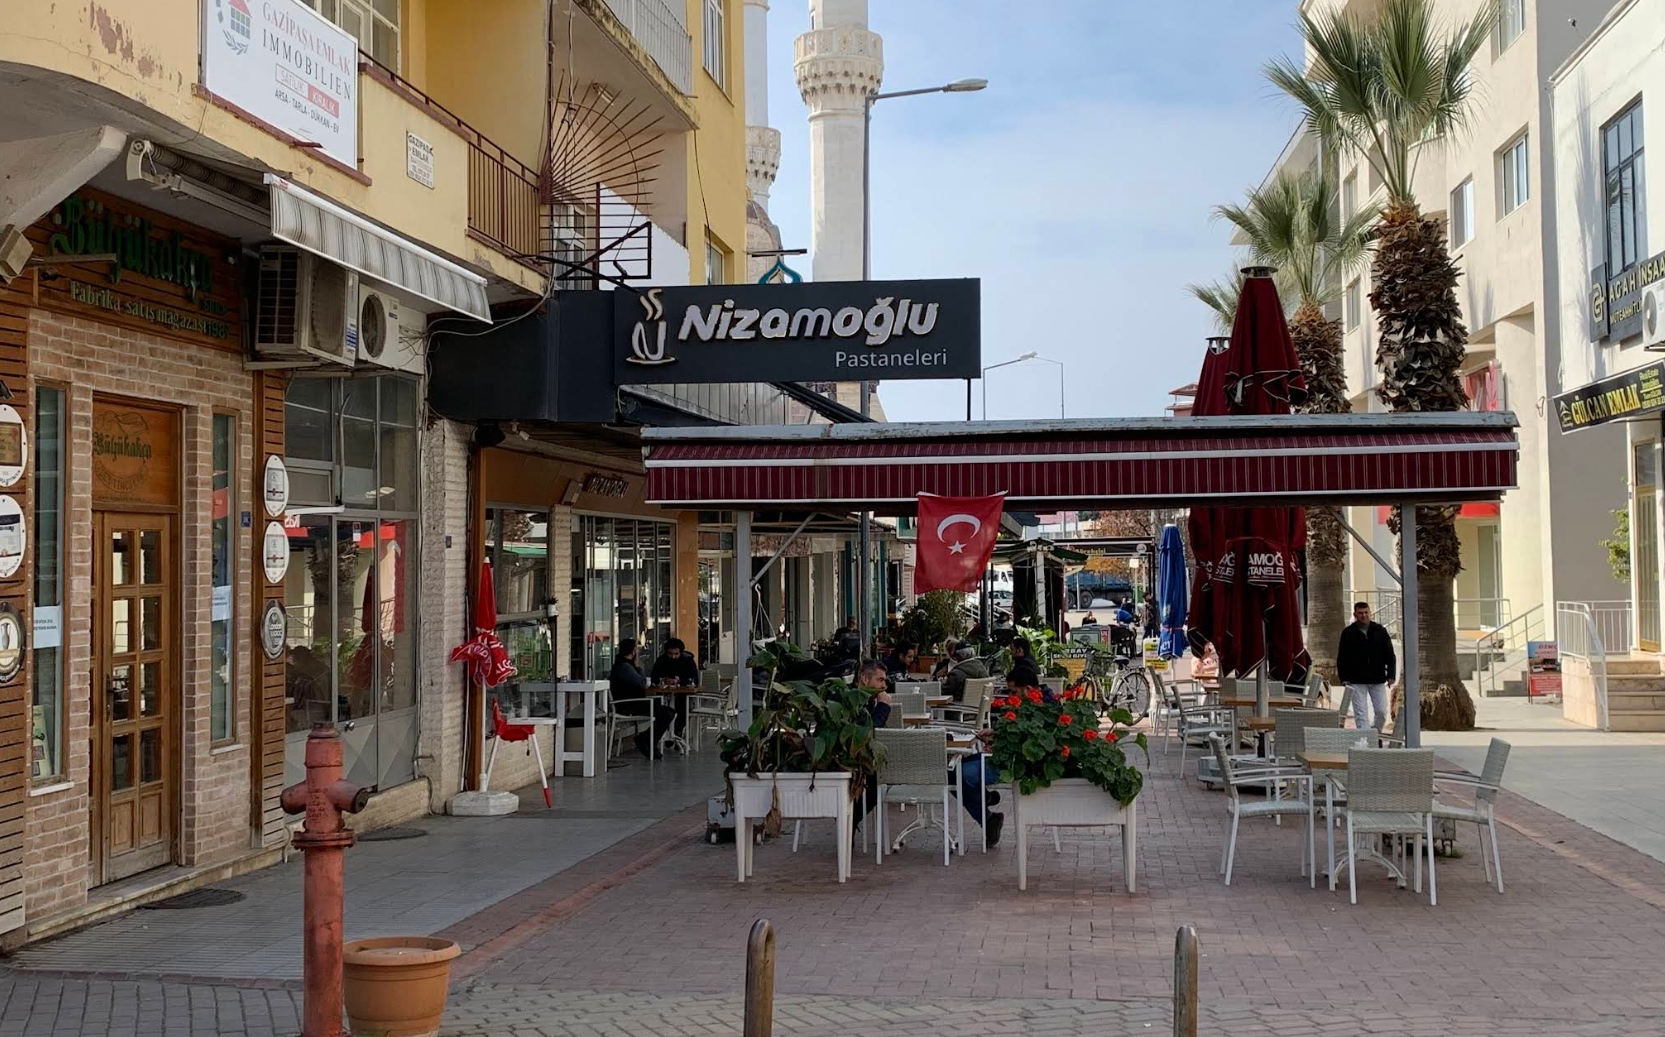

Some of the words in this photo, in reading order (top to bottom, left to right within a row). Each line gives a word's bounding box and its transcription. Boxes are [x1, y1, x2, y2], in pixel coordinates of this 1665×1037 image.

[263, 28, 351, 101] IMMOBILIEN
[316, 36, 350, 76] EMLAK
[275, 89, 289, 105] ARSA
[70, 280, 121, 313] Fabrika
[126, 300, 155, 323] satış
[1609, 272, 1637, 304] AGAH
[677, 296, 940, 346] Nizamoğlu
[835, 349, 948, 368] Pastaneleri
[1606, 383, 1641, 416] EMLAK
